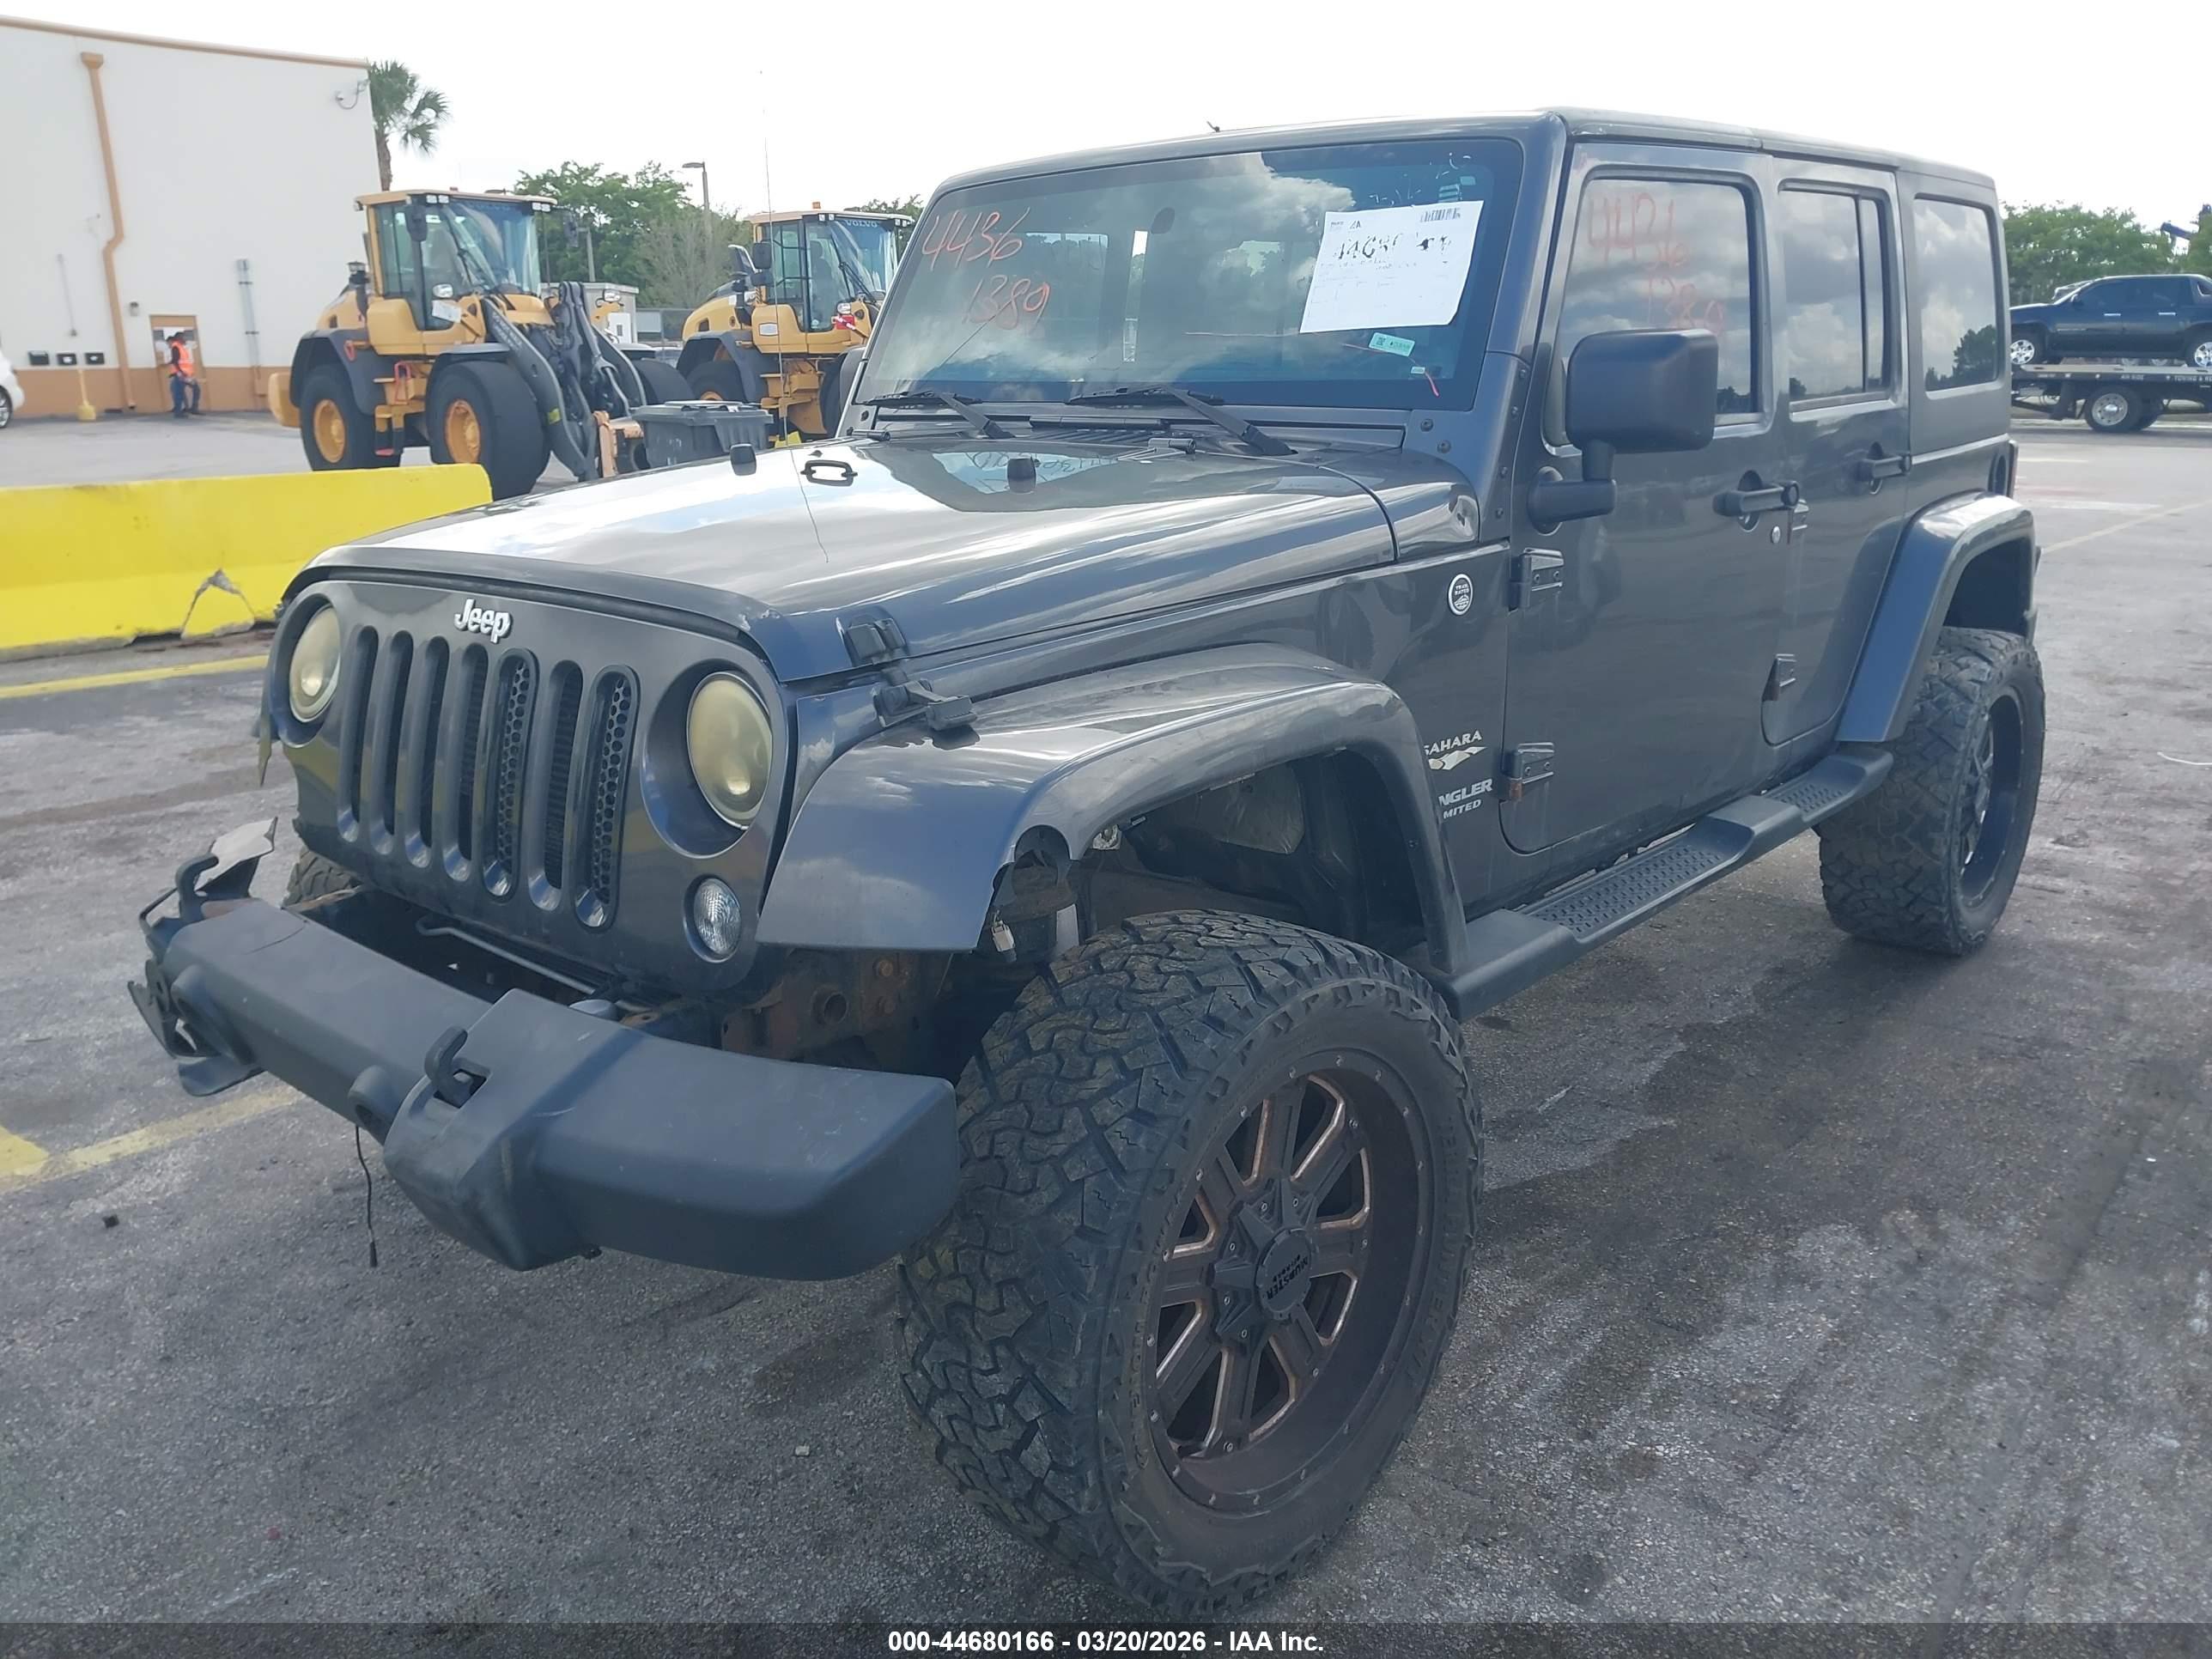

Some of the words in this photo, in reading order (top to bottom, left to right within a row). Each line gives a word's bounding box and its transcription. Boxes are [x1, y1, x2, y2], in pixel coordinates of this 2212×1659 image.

[844, 219, 878, 228] VOLVO
[921, 206, 1030, 271] 4436
[961, 274, 1052, 331] 1389
[453, 599, 513, 644] Jeep
[1438, 779, 1492, 807] NGLER
[1443, 799, 1482, 819] MITED
